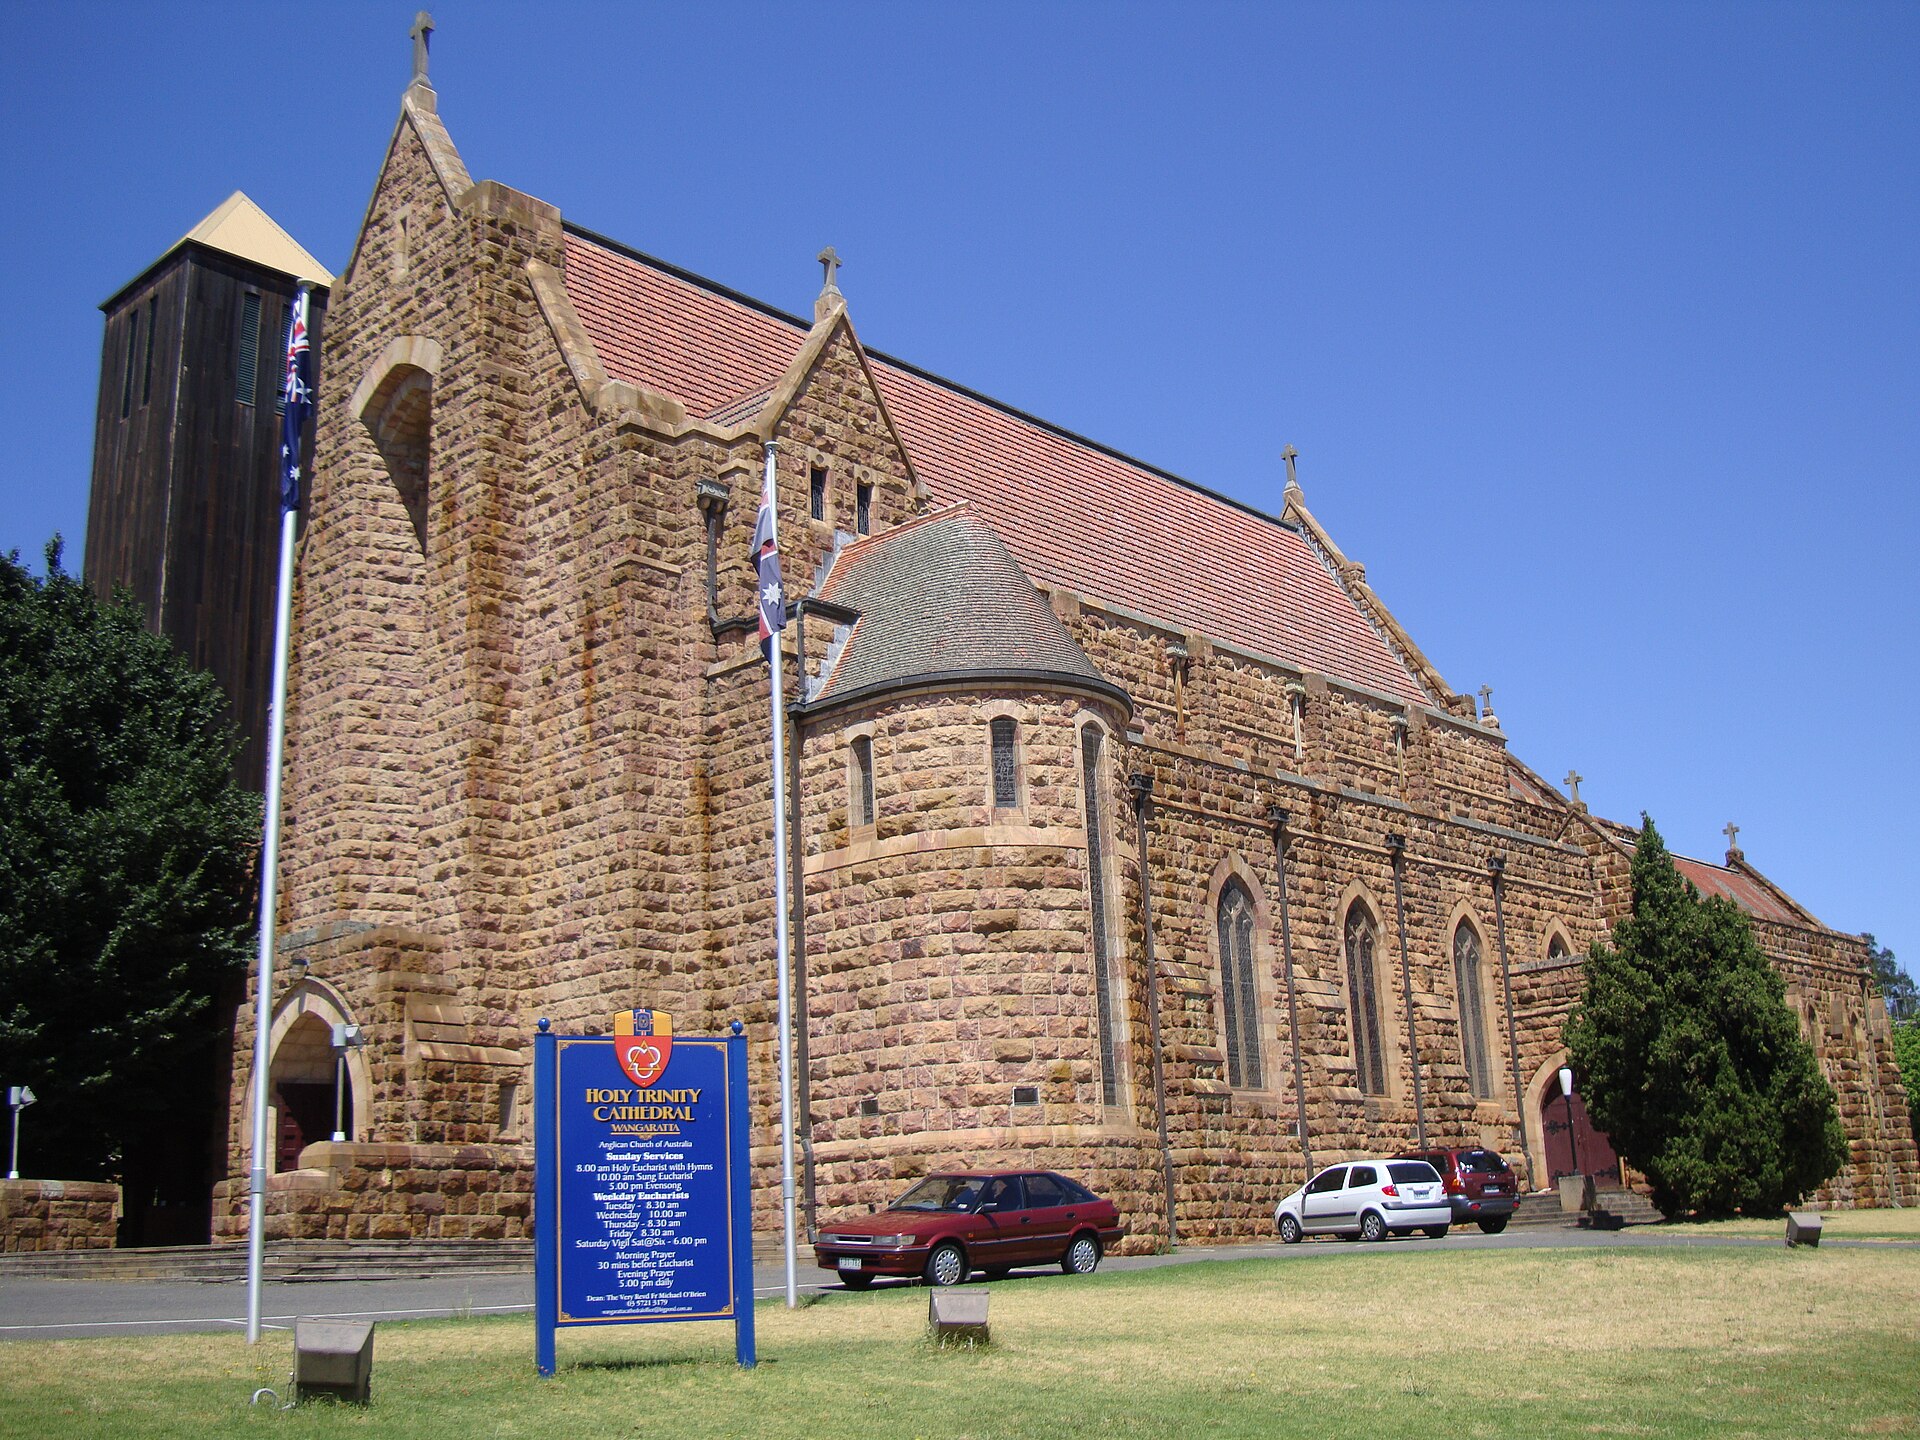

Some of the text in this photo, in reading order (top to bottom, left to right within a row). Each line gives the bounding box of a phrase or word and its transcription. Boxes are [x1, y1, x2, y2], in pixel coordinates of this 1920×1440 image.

[586, 1088, 702, 1104] HOLY TRINITY
[593, 1106, 695, 1122] CATHEDRAL
[611, 1124, 680, 1132] WANGARATTA
[599, 1141, 628, 1150] Anglican
[606, 1152, 684, 1162] Sunday Services
[612, 1164, 631, 1173] Holy
[633, 1164, 667, 1172] Eucharist
[688, 1163, 713, 1173] Hymns
[596, 1173, 621, 1181] 10.00
[636, 1173, 656, 1182] Sung
[658, 1172, 693, 1180] Eucharist
[610, 1182, 682, 1193] 5.00 pm Evensong
[594, 1192, 689, 1201] Weekday Eucharists
[604, 1202, 635, 1212] Tuesday
[646, 1201, 665, 1209] 8.30
[596, 1211, 641, 1221] Wednesday
[604, 1220, 640, 1230] Thursday
[648, 1220, 667, 1228] 8.30
[610, 1229, 634, 1239] Friday
[641, 1229, 660, 1237] 8.30
[576, 1239, 611, 1249] Saturday
[612, 1239, 630, 1249] Vigil
[631, 1237, 666, 1246] Sat@Six
[674, 1237, 693, 1245] 6.00
[695, 1239, 707, 1247] pm
[616, 1251, 676, 1261] Morning Prayer
[598, 1259, 694, 1270] 30 mins before Eucharist
[617, 1269, 675, 1279] Evening Prayer
[619, 1279, 674, 1289] 5.00 pm daily
